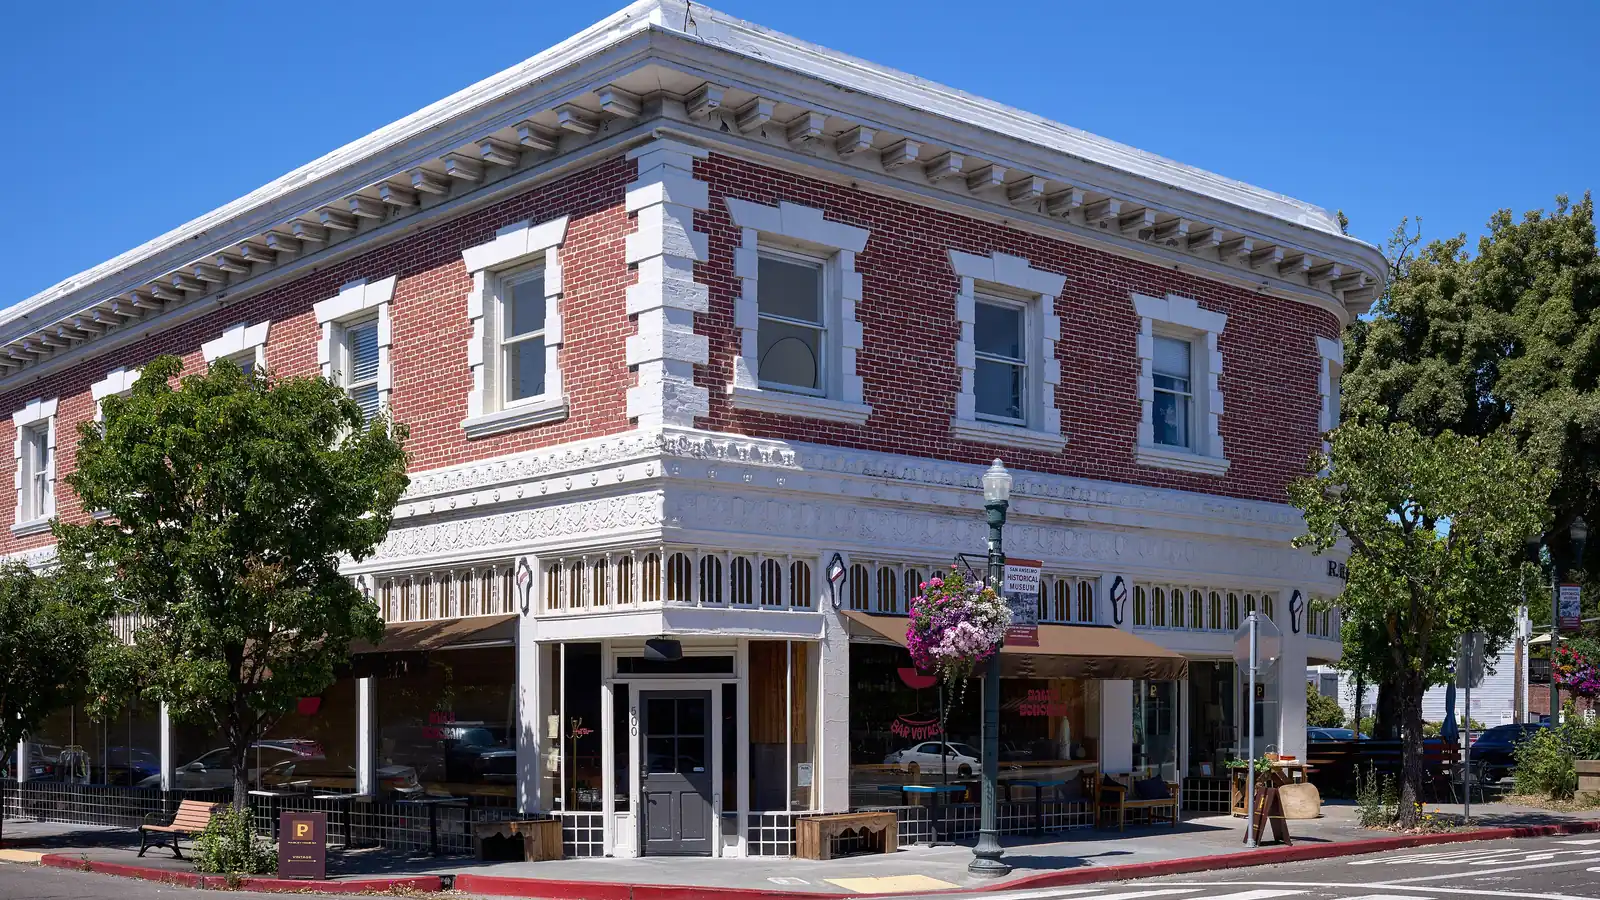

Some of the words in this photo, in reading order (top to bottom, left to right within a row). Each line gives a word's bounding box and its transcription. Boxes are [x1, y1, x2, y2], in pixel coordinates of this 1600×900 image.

[1008, 574, 1039, 583] HISTORICAL
[1010, 583, 1035, 591] MUSEUM
[890, 719, 910, 738] BAR
[297, 824, 309, 837] P
